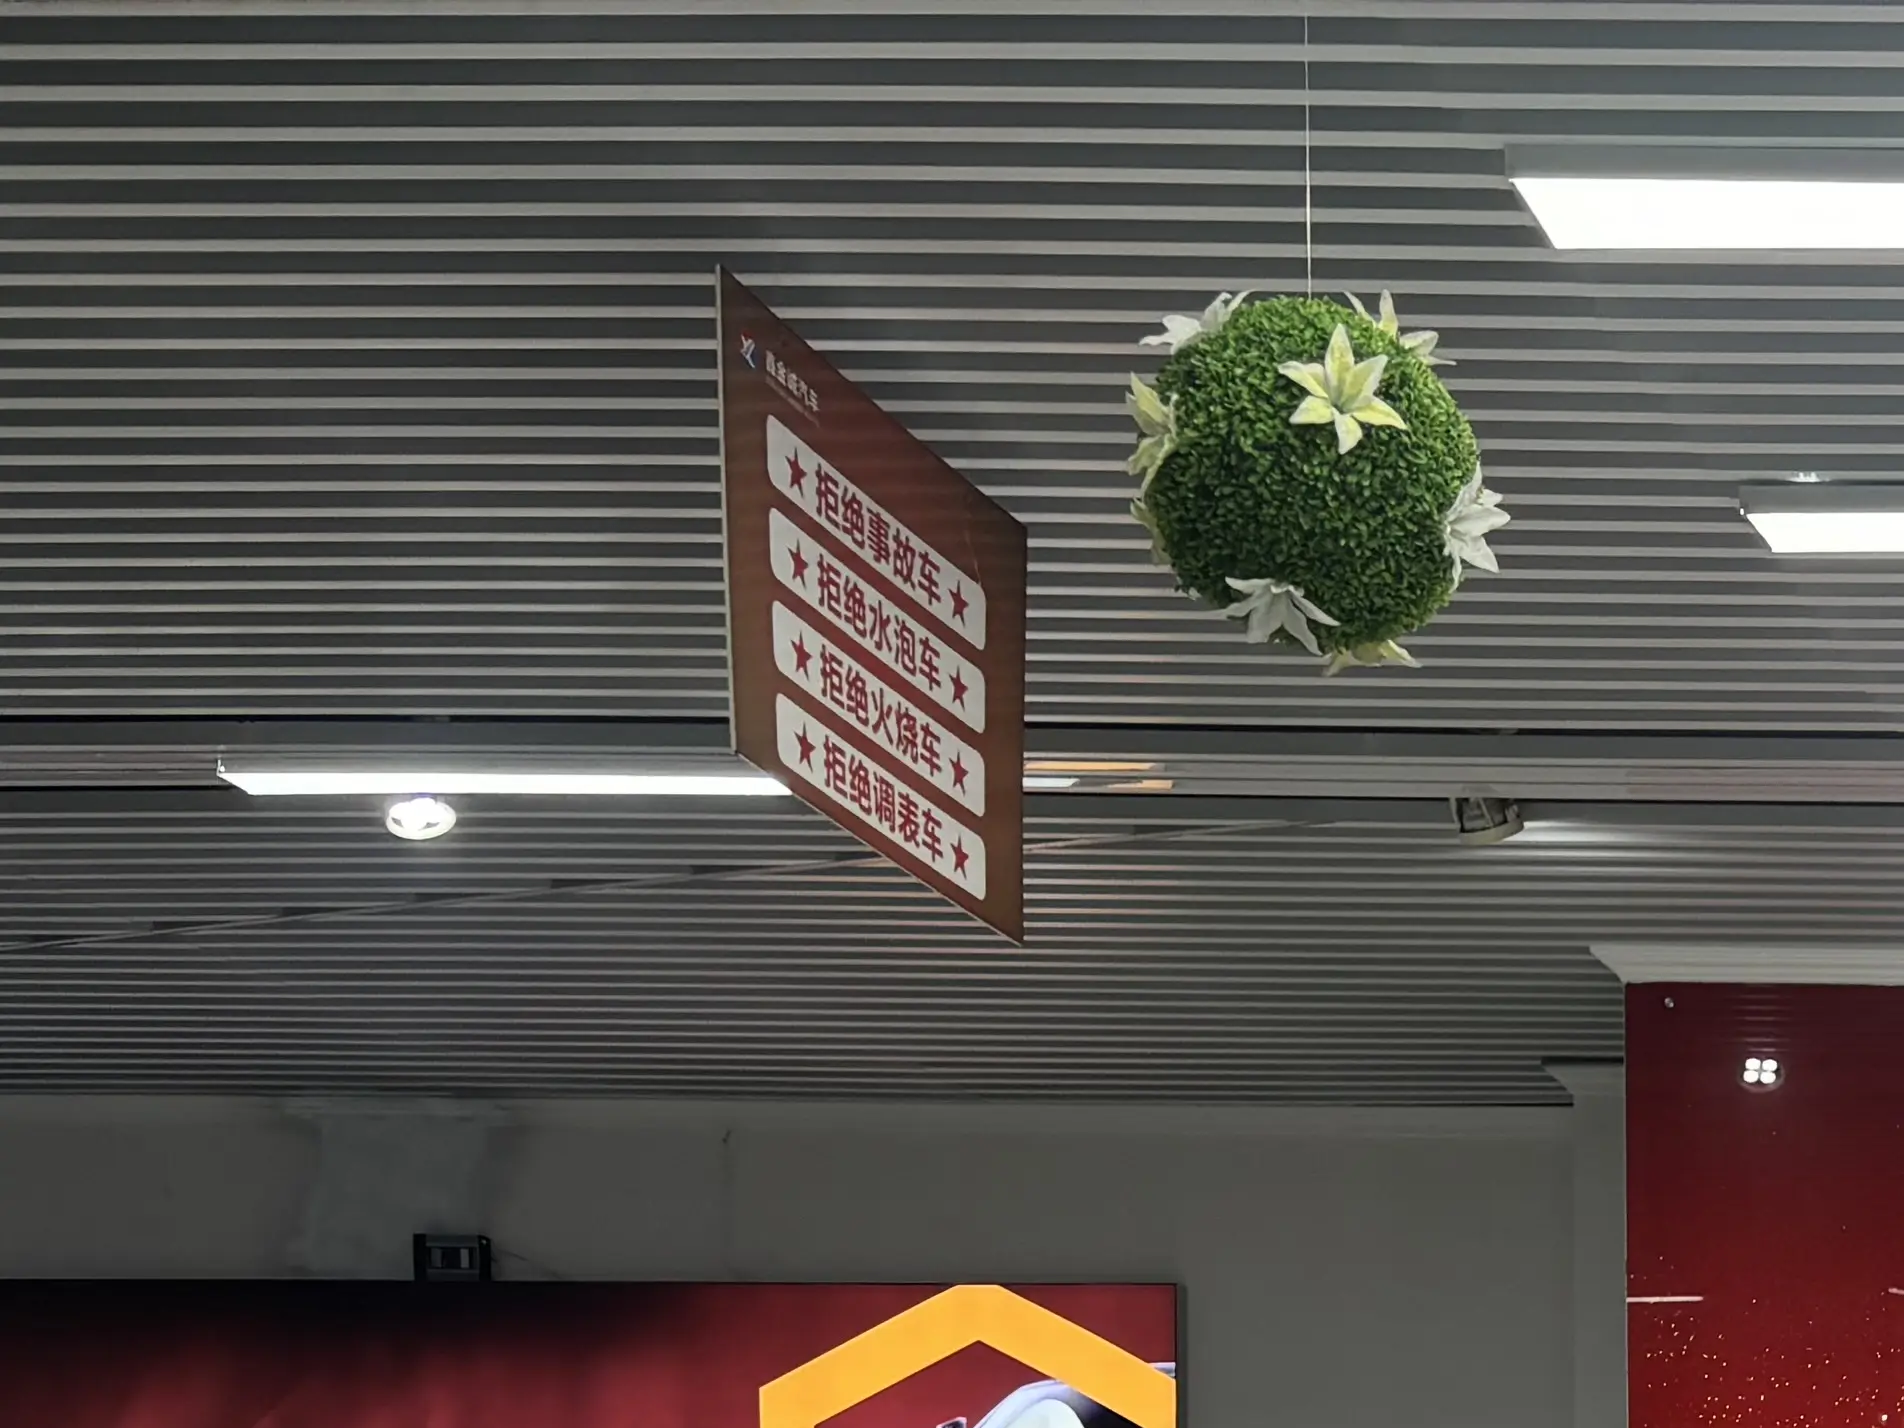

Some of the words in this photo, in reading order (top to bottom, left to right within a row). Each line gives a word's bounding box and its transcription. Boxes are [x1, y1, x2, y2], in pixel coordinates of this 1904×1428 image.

[815, 462, 941, 608] 拒绝事故车
[817, 554, 941, 692] 拒绝水泡车
[819, 645, 942, 778] 拒绝火烧车
[822, 735, 943, 864] 拒绝调表车
